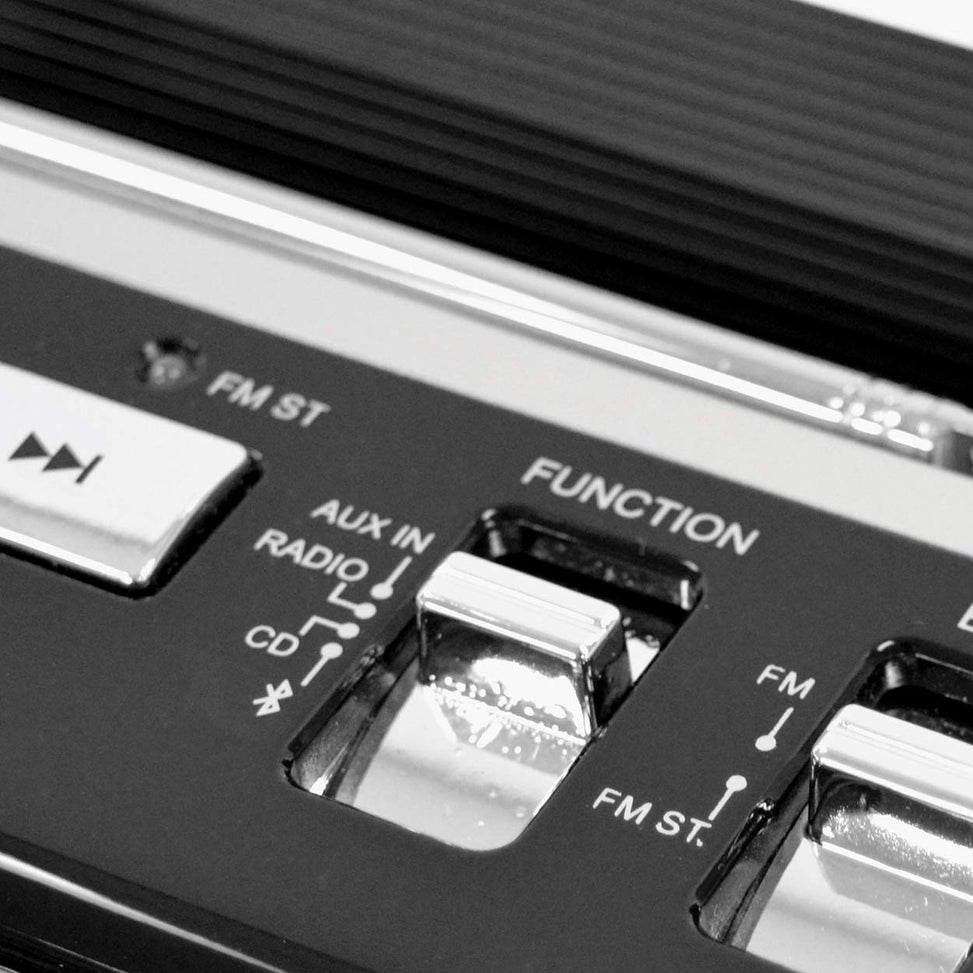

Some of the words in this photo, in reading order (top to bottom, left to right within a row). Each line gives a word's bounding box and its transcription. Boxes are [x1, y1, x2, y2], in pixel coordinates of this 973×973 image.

[207, 370, 274, 411] FM
[270, 393, 331, 428] ST
[310, 499, 393, 540] AUX
[390, 524, 436, 555] IN
[522, 457, 760, 556] FUNCTION
[253, 528, 369, 583] RADIO
[244, 624, 300, 658] CD
[756, 664, 816, 701] FM
[592, 787, 653, 826] FM
[655, 810, 713, 848] ST.
